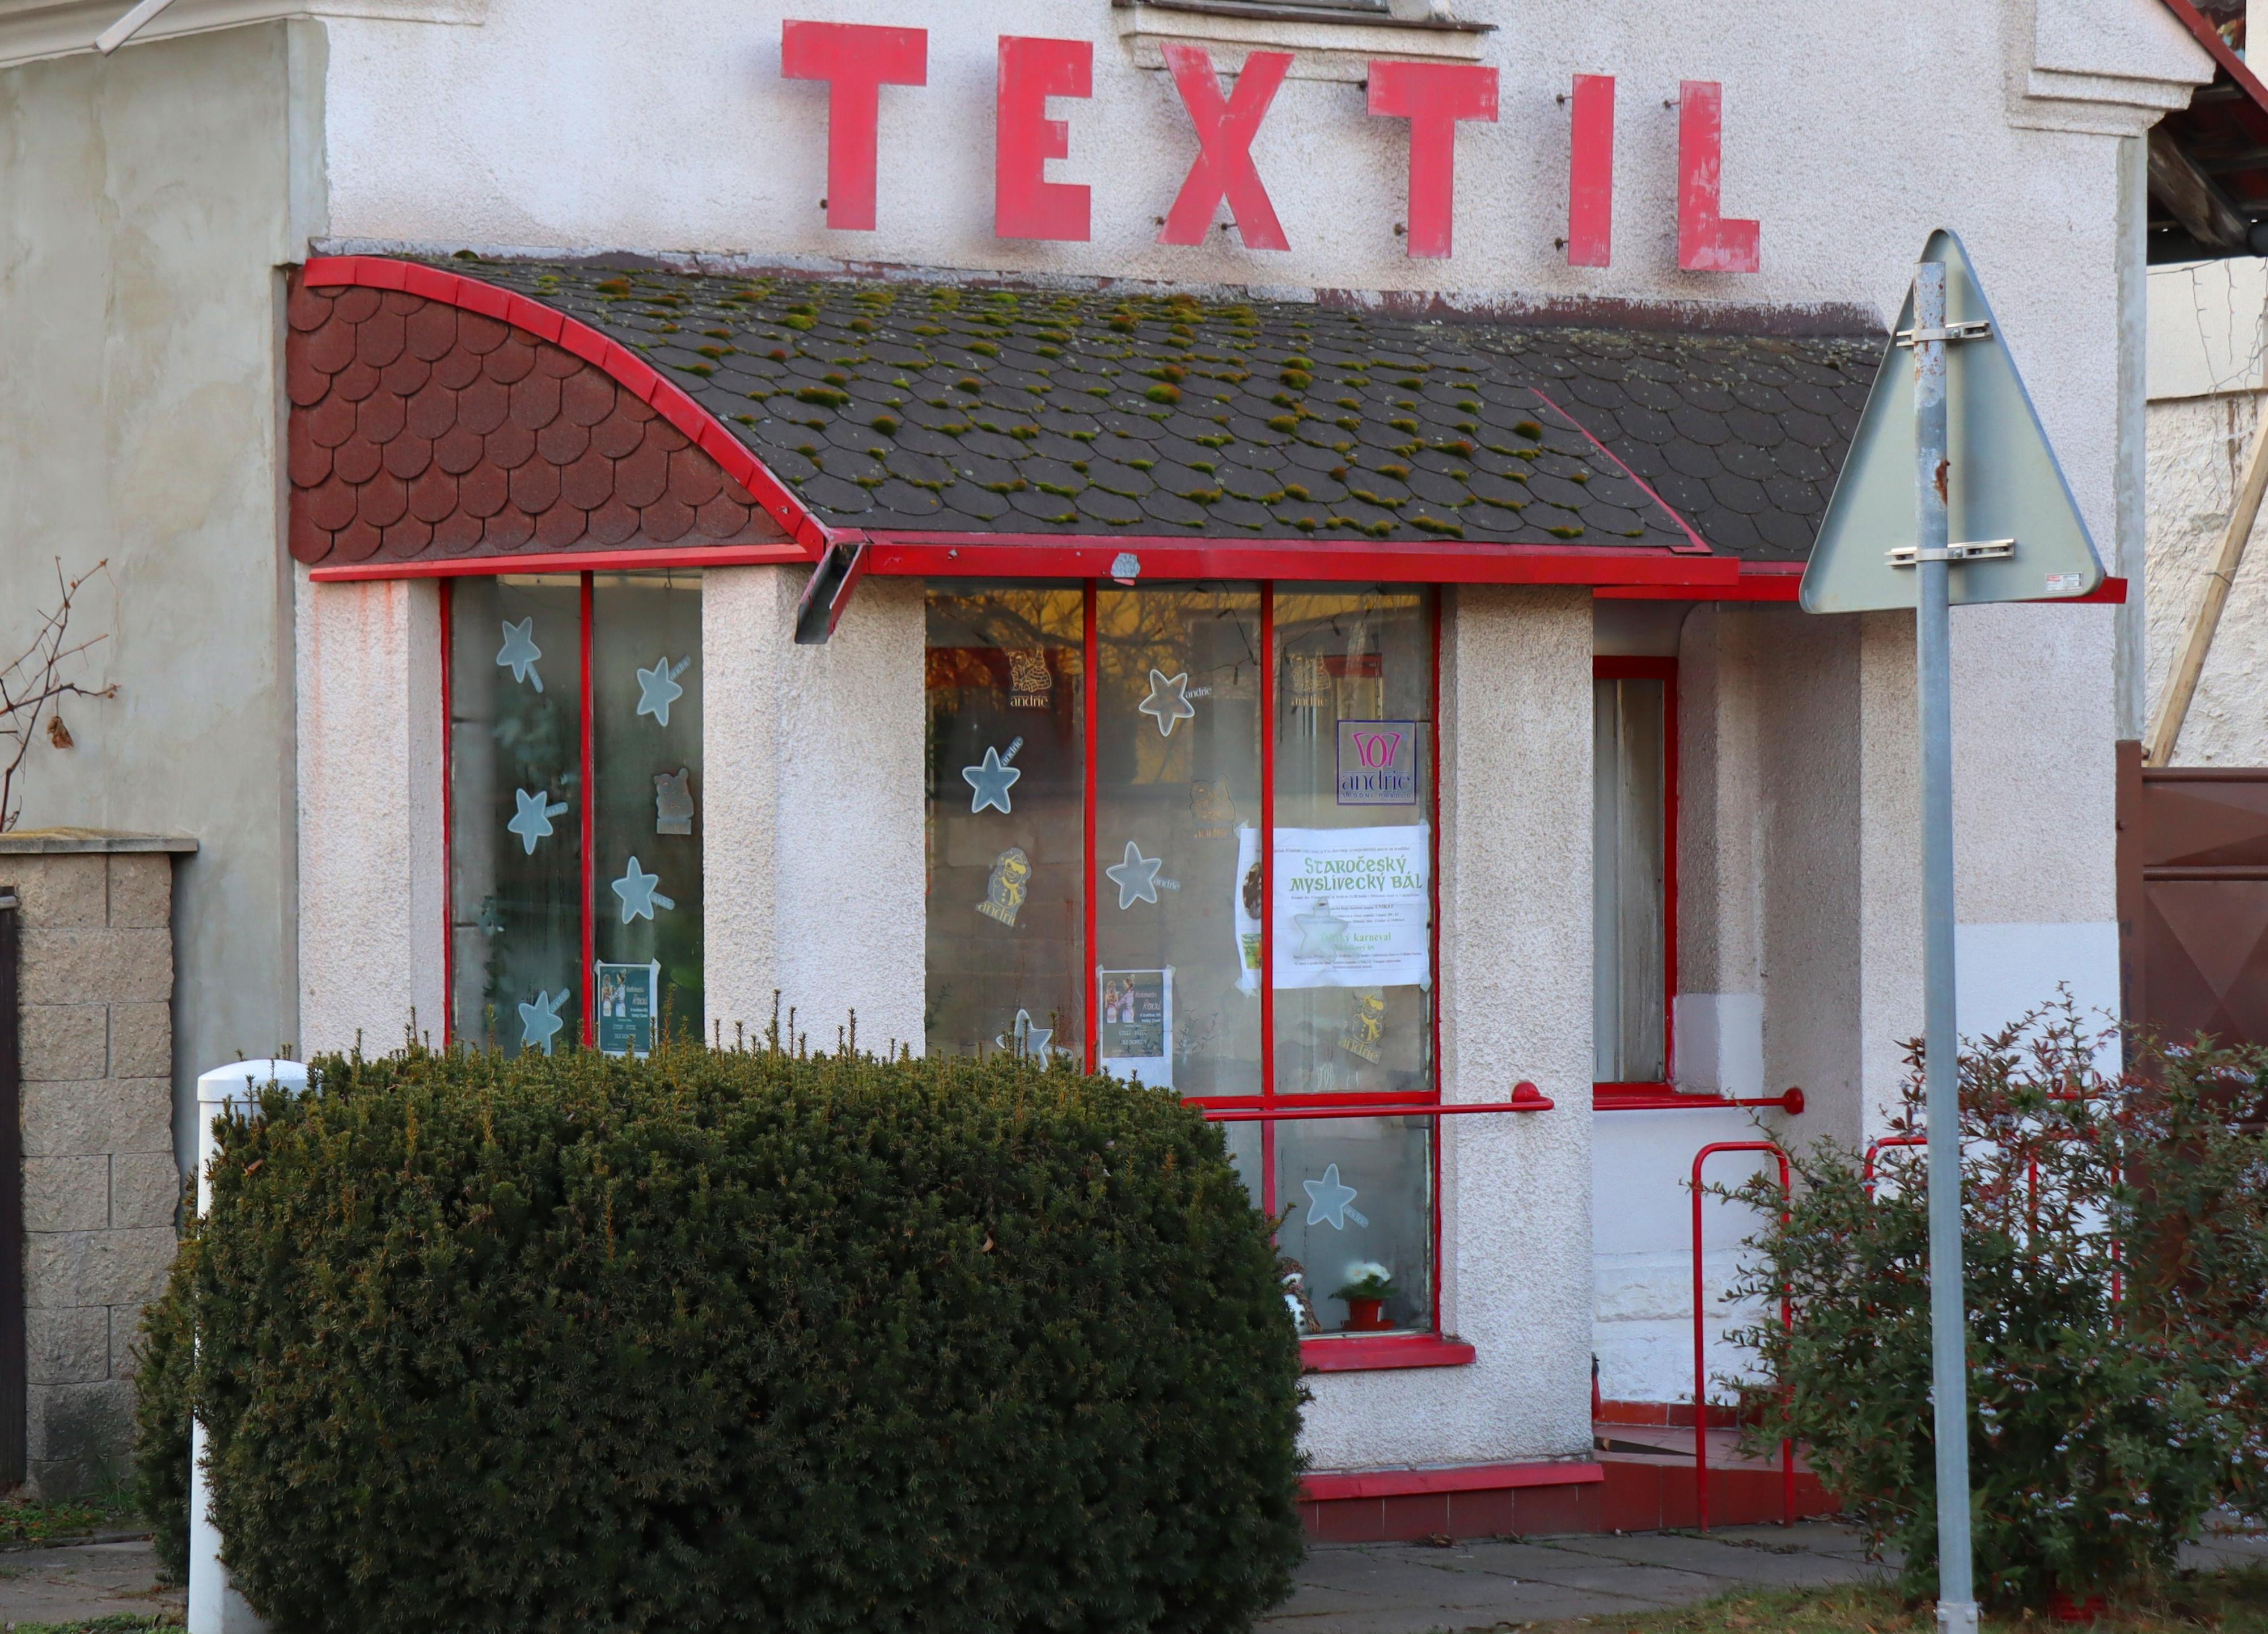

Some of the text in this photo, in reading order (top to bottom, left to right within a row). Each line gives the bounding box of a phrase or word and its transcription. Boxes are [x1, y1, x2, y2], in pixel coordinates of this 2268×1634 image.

[781, 19, 1760, 273] TEXTIL
[1010, 694, 1048, 707] andrie
[1185, 687, 1212, 698] andrie
[1342, 770, 1411, 791] andrie
[1353, 931, 1391, 942] karneval
[1339, 1037, 1378, 1061] andrie
